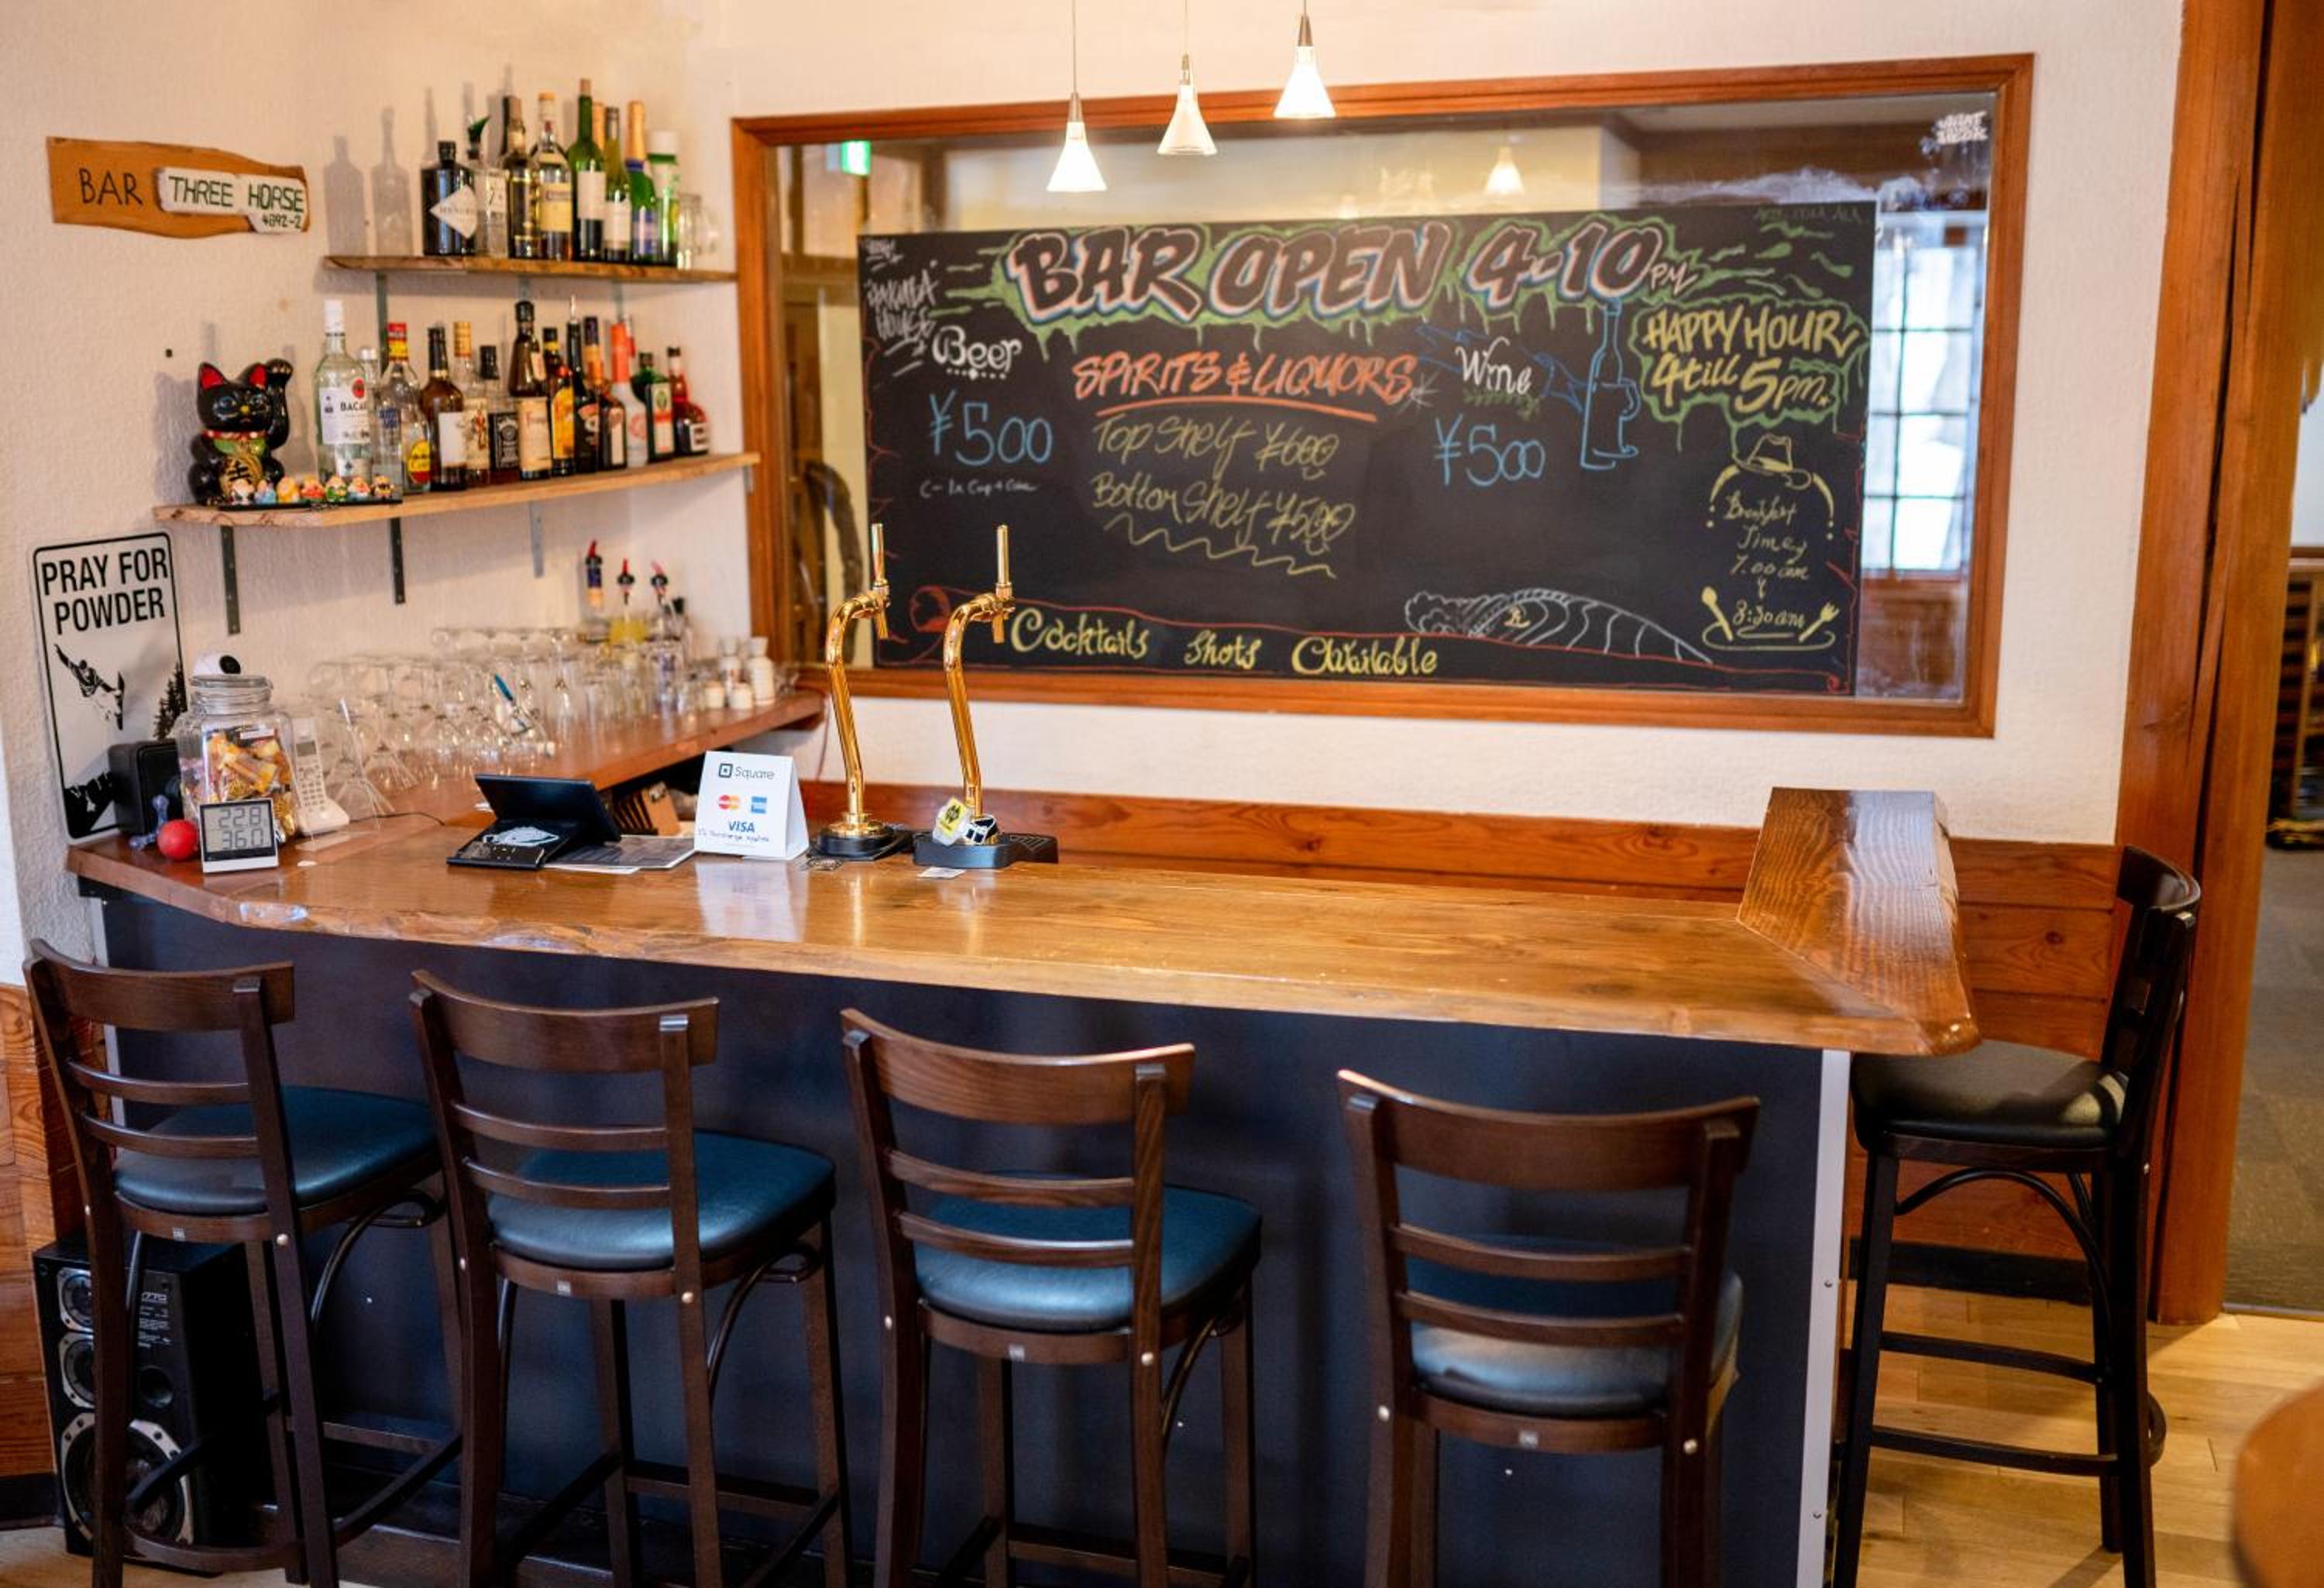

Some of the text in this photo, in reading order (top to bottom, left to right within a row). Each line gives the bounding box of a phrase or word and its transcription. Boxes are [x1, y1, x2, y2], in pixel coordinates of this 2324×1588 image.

[78, 167, 304, 213] BAR THREE HORSE
[1012, 227, 1202, 322] BAR
[1212, 222, 1452, 318] OPEN
[1468, 222, 1663, 308] 4-10
[932, 325, 1023, 373] Beer
[1642, 304, 1860, 359] HAPPY HOUR
[1072, 351, 1419, 405] SPIRITS & LIQUORS
[1456, 336, 1532, 396] Wine
[929, 389, 1054, 466] ¥500
[1092, 413, 1339, 480] Top Shelf ¥600
[1435, 414, 1545, 486] ¥500
[1182, 481, 1270, 549] Shelf
[41, 547, 168, 596] PRAY FOR
[54, 586, 165, 635] POWDER
[1011, 607, 1150, 658] Cocktails
[1184, 629, 1263, 670] Shots
[735, 766, 775, 779] Square
[729, 820, 755, 833] VISA
